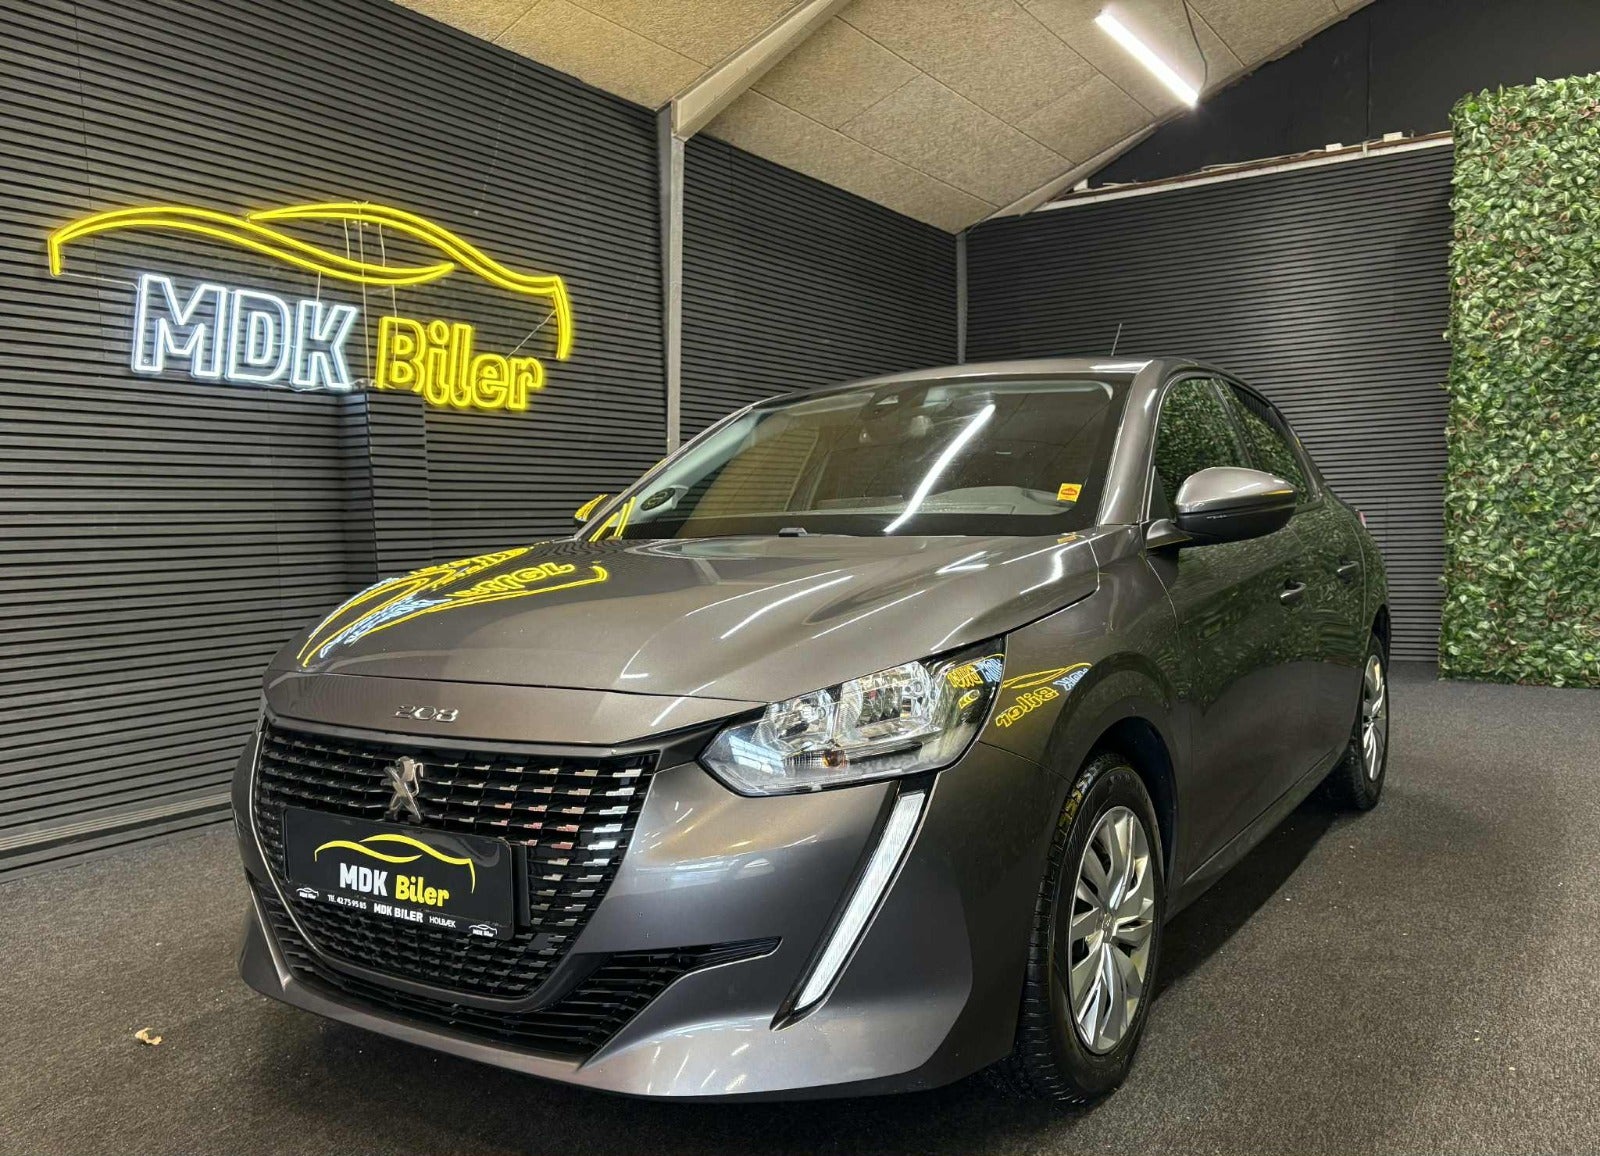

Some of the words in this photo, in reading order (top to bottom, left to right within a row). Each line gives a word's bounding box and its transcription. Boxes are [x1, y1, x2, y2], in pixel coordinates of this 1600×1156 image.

[131, 273, 357, 389] MDK
[375, 315, 543, 410] Biler
[394, 705, 459, 722] 208
[339, 862, 388, 897] MDK
[395, 874, 450, 907] Biler
[373, 902, 392, 917] MDK
[394, 907, 424, 923] BILER
